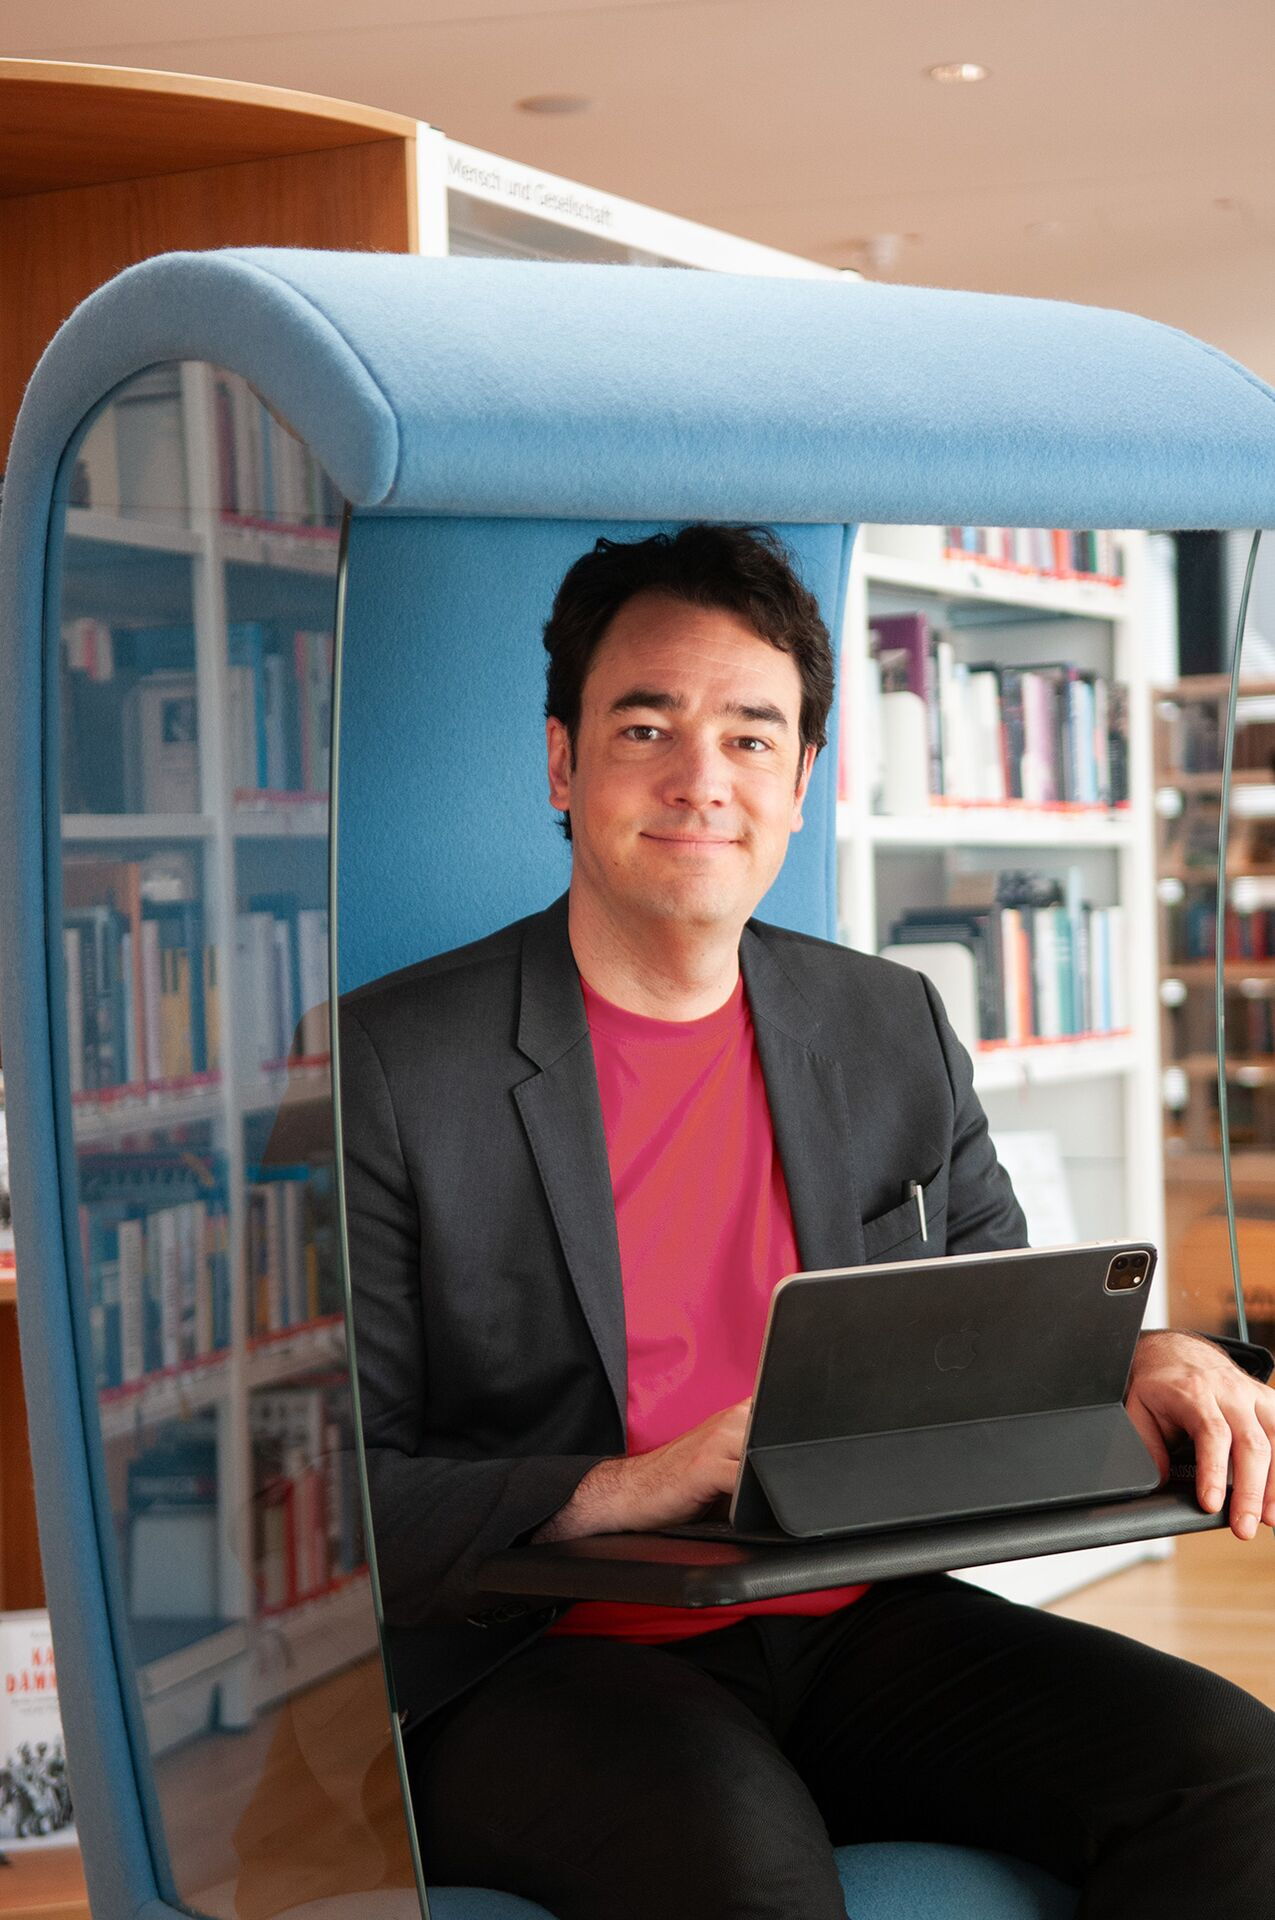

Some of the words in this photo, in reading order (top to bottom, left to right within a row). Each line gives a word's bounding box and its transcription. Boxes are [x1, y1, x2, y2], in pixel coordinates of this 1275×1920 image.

[448, 155, 500, 191] Mensch
[505, 176, 531, 201] und
[534, 182, 613, 226] Gesellschaft
